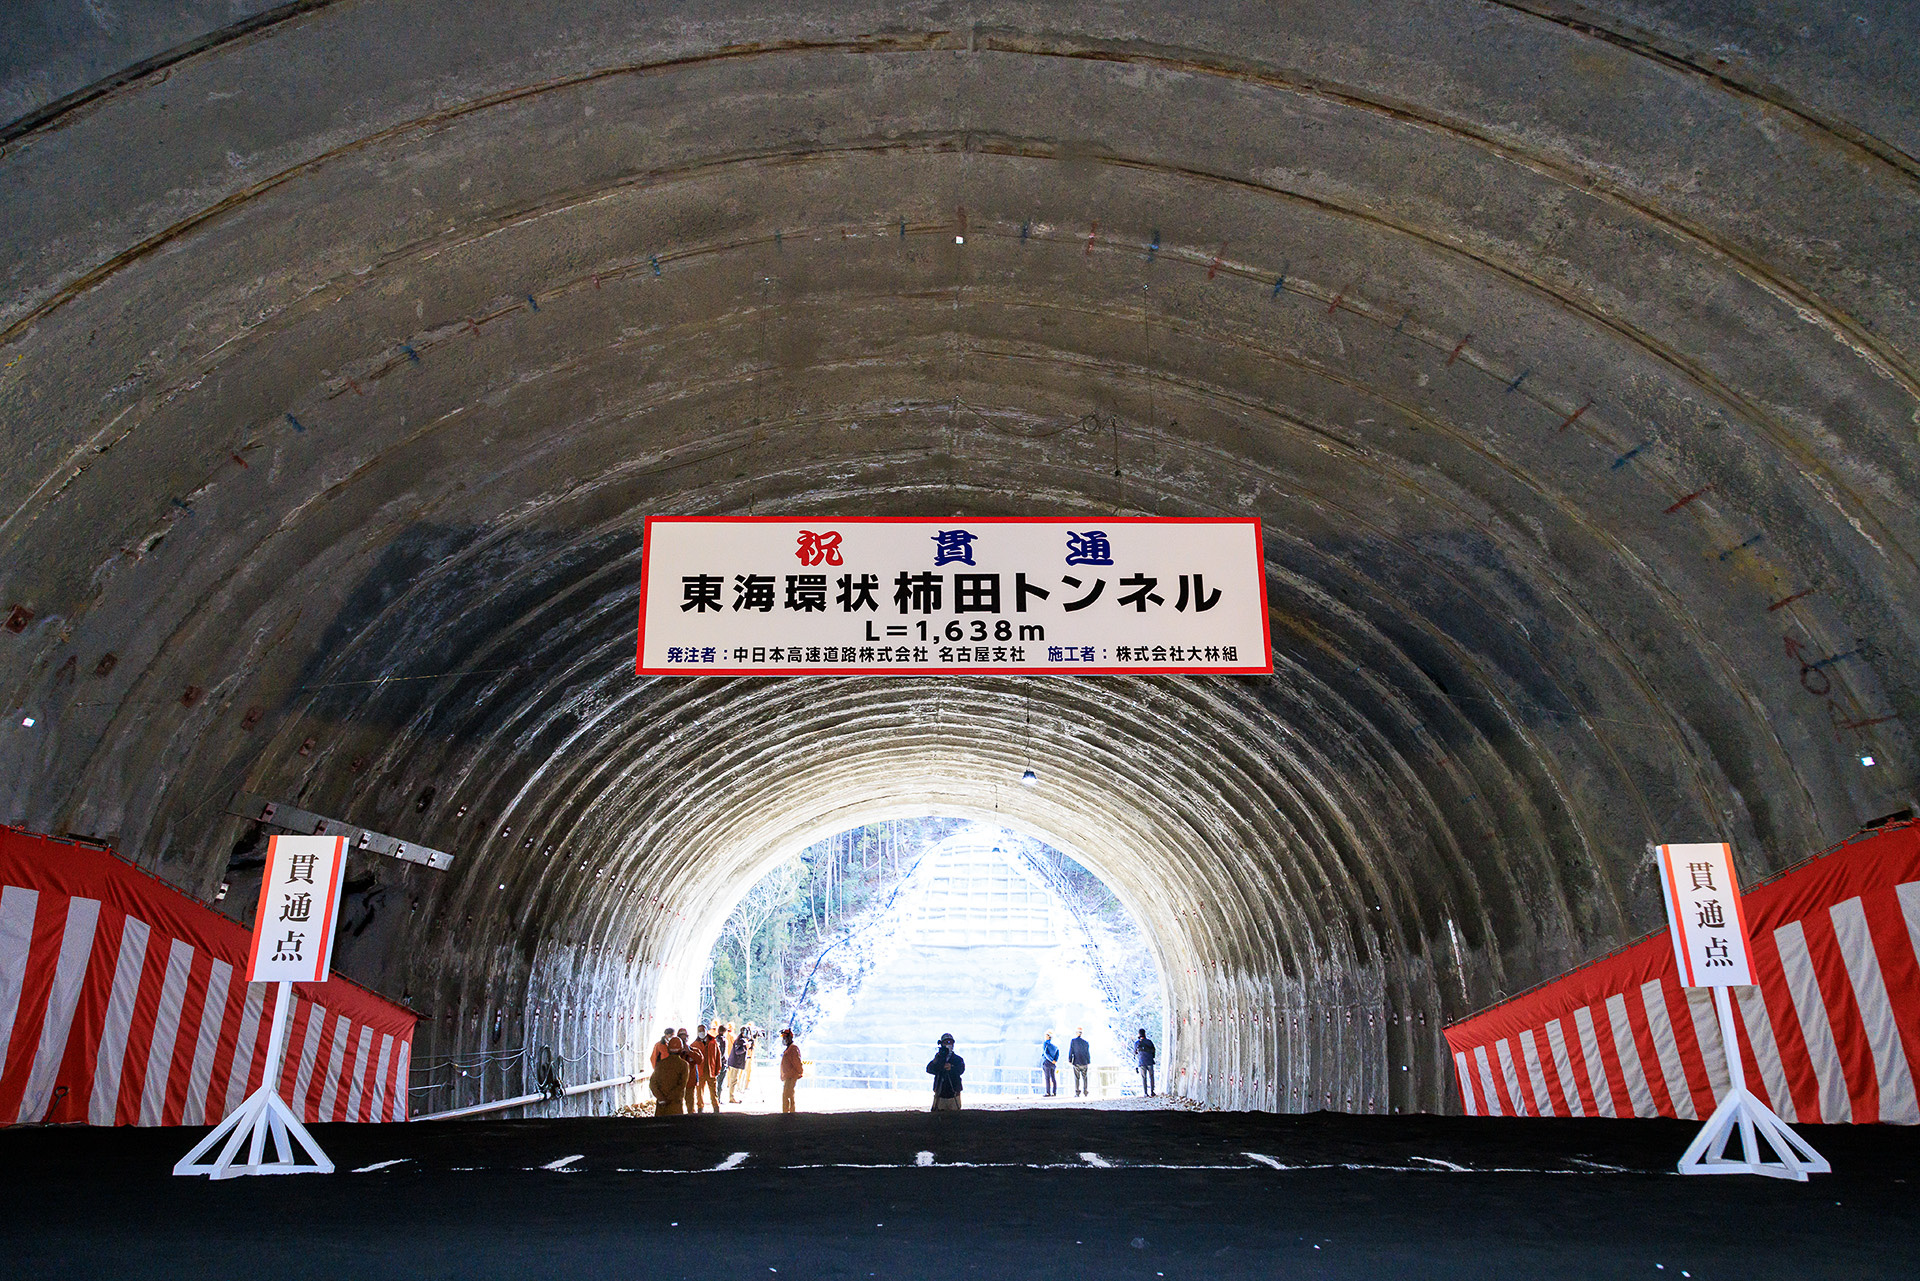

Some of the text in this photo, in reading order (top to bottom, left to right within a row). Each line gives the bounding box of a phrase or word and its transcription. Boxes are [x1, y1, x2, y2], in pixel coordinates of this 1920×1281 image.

[795, 529, 1115, 567] 祝 貫 通
[865, 619, 1046, 645] L=1,638m
[938, 646, 1026, 662] 名古屋支社
[271, 854, 320, 961] 貫通点
[1686, 862, 1734, 967] 貫通点
